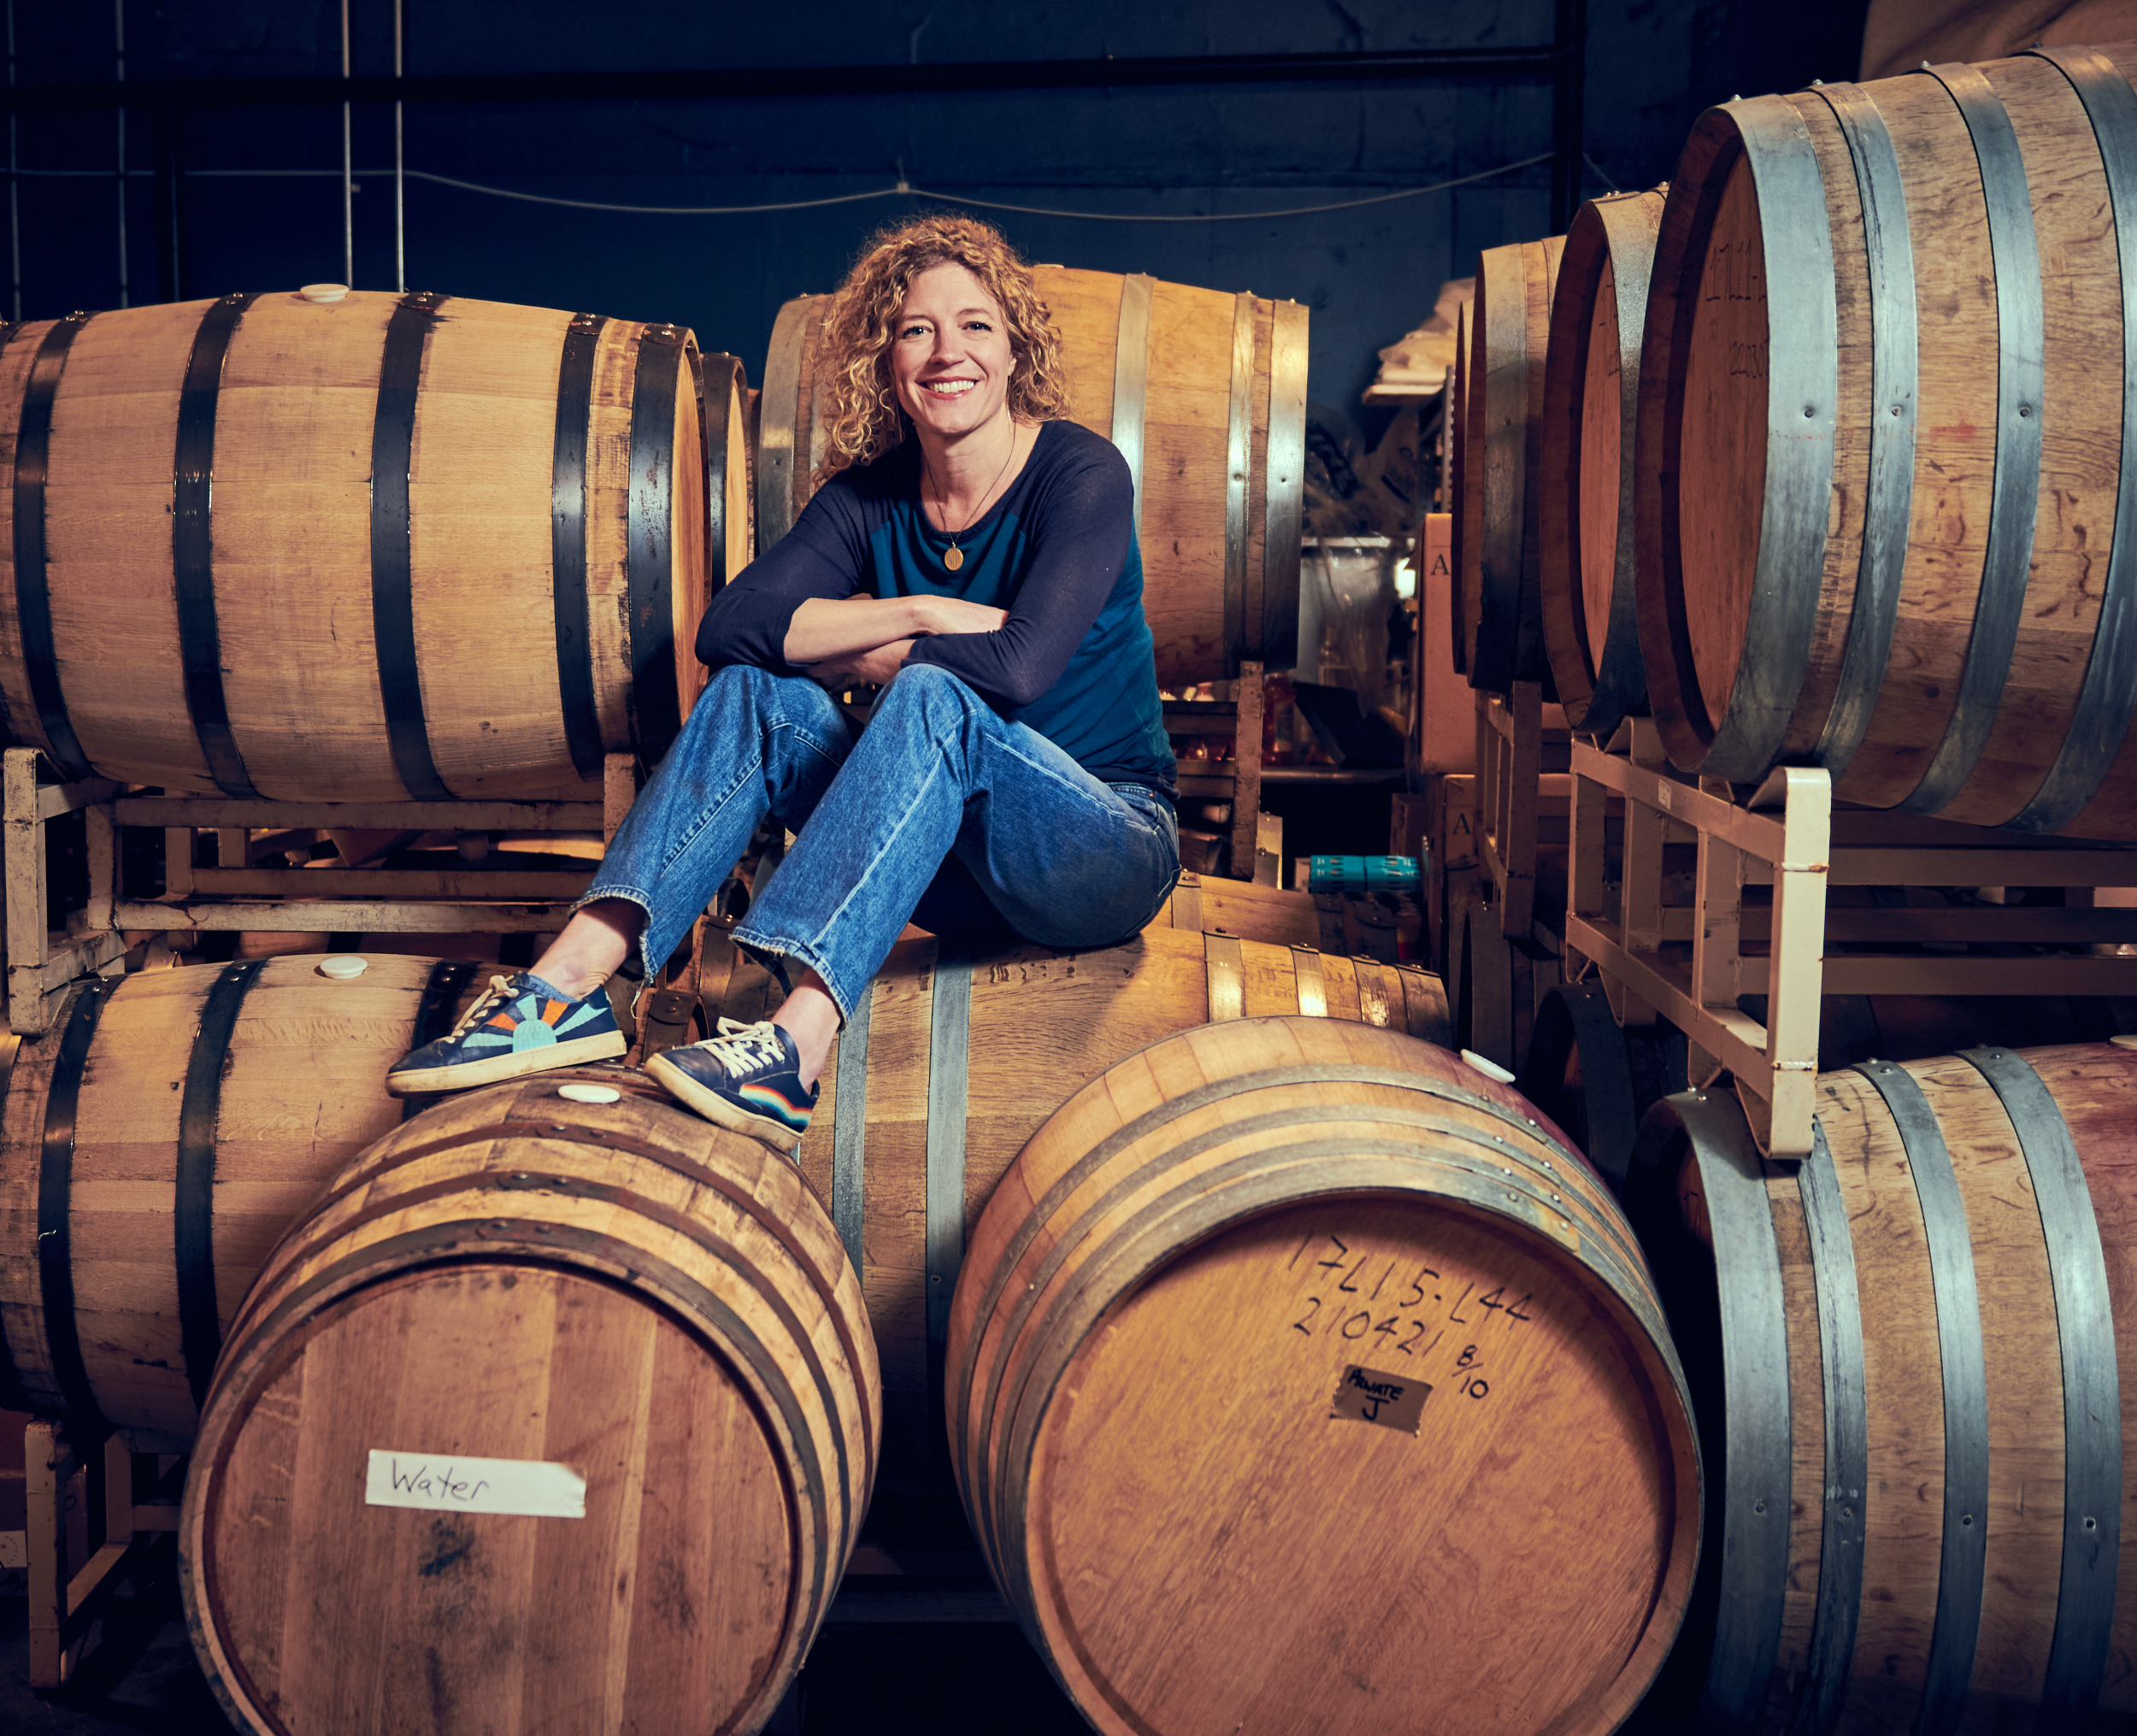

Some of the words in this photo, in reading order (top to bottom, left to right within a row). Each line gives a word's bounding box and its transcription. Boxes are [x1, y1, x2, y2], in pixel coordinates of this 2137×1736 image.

[1430, 554, 1450, 575] A
[1452, 812, 1471, 834] A
[1293, 1296, 1445, 1358] 210421
[1363, 1395, 1390, 1421] J
[392, 1458, 489, 1502] Water
